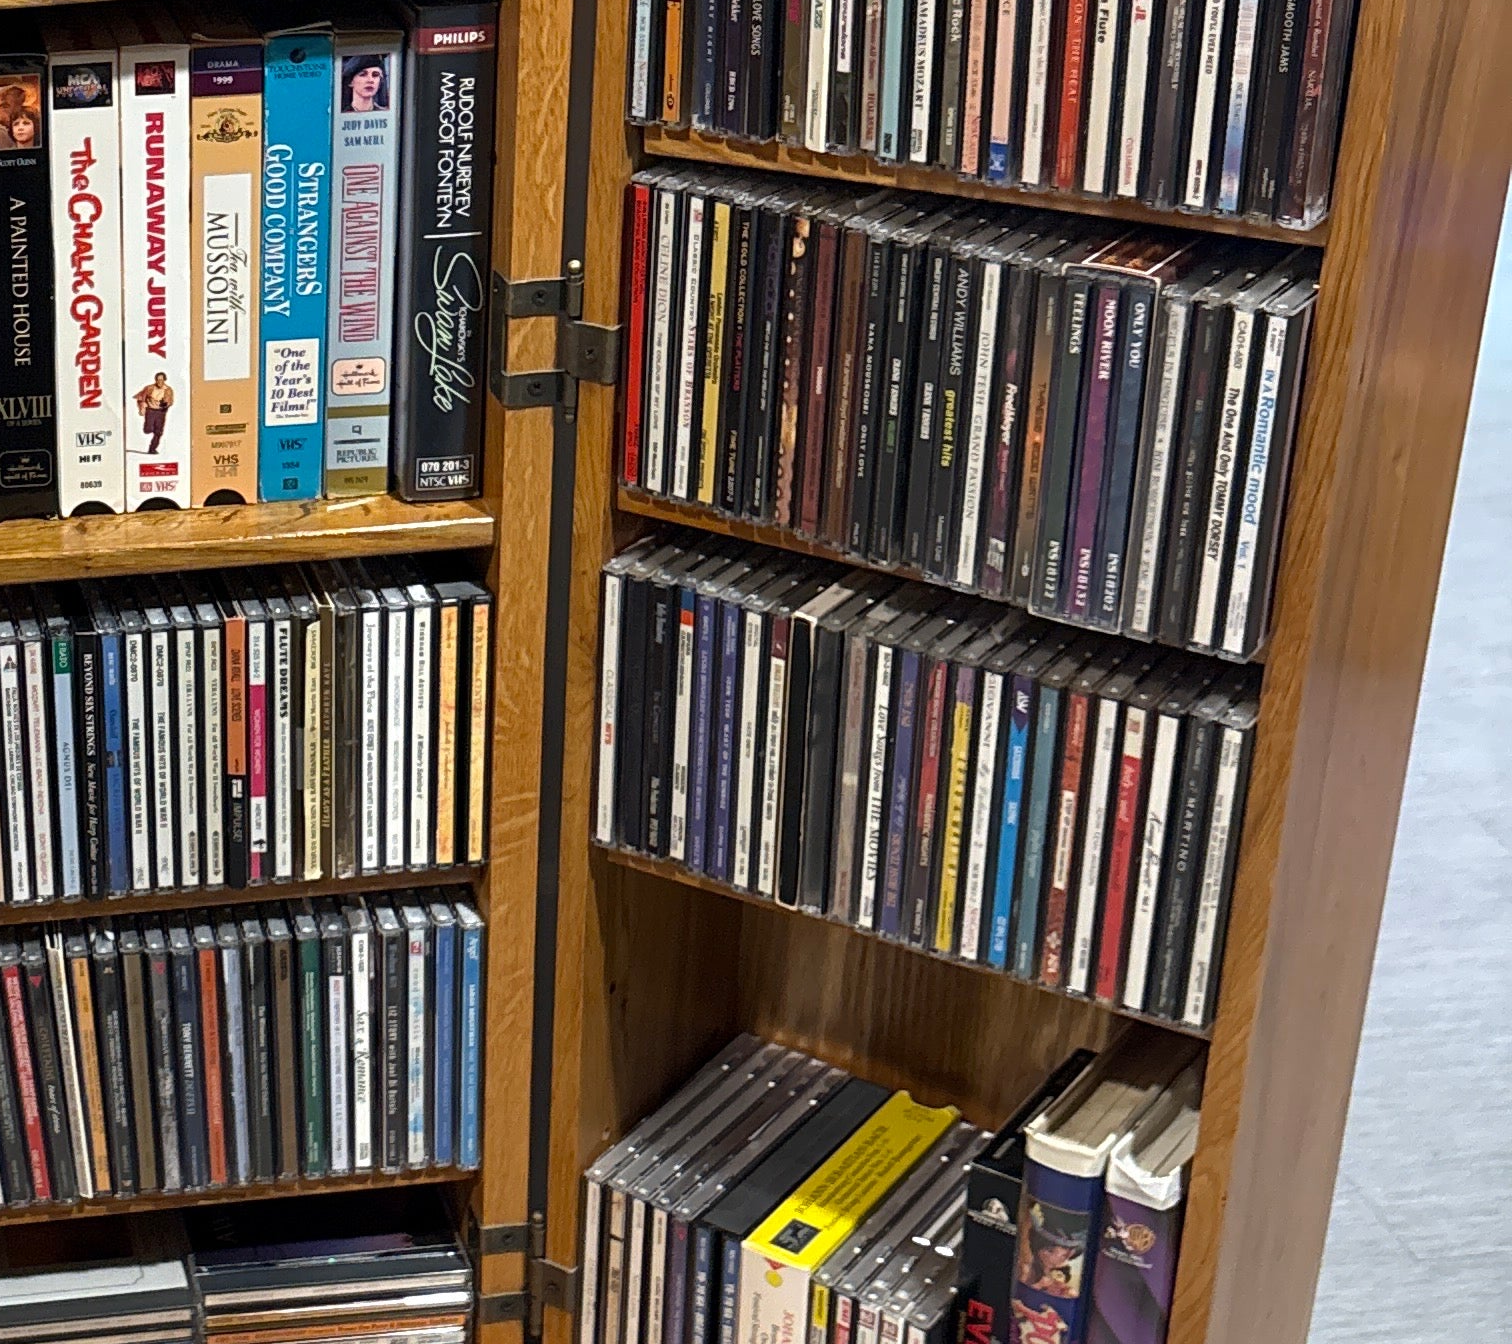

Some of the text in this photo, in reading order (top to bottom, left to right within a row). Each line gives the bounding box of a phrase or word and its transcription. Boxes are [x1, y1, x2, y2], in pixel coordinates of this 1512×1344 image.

[434, 31, 486, 45] PHILIPS
[751, 25, 762, 55] SONGS
[917, 0, 930, 56] AMADEUS
[951, 10, 964, 42] Rock
[1097, 9, 1110, 43] Flute
[208, 60, 239, 69] DRAMA
[1278, 44, 1292, 73] JAMS
[213, 75, 233, 84] 1999
[915, 60, 927, 110] MOZART
[436, 72, 458, 228] MARGOT FONTEYN
[455, 76, 476, 217] RUDOLF NUREYEV
[145, 113, 166, 358] RUNAWAY JURY
[263, 144, 293, 317] GOOD COMPANY
[295, 162, 325, 296] STRANGERS
[340, 164, 380, 343] ONE AGAINST THE WIND
[9, 197, 31, 367] A PAINTED HOUSE
[69, 136, 103, 410] The CHALK GARDEN
[207, 213, 229, 346] MUSSOLINI
[1069, 292, 1084, 354] FEELINGS
[1098, 299, 1116, 380] MOON RIVER
[1128, 303, 1145, 368] ONLY YOU
[274, 375, 311, 387] Year's
[275, 361, 310, 371] of the
[940, 269, 968, 467] ANDY WILLIAMS greatest hits
[1265, 369, 1276, 381] IN
[271, 388, 314, 399] 10 Best
[78, 431, 105, 445] VHS
[1250, 396, 1276, 473] Romantic
[213, 454, 239, 465] VHS
[421, 459, 470, 473] 070 201-3
[1208, 388, 1239, 560] The One And Only TOMMY DORSEY
[420, 473, 469, 486] NTSC VHS
[1244, 478, 1261, 524] mood
[83, 654, 94, 693] BEYOND
[279, 628, 288, 718] FLUTE DREAMS
[85, 696, 94, 711] SIX
[876, 705, 888, 731] Love
[86, 714, 96, 755] STRINGS
[874, 734, 887, 764] Songs
[87, 762, 96, 778] New
[88, 780, 96, 801] Music
[88, 817, 99, 835] Harp
[871, 797, 882, 822] THE
[90, 838, 99, 861] Guitar
[1177, 798, 1196, 872] MARTINO
[866, 827, 880, 880] MOVIES
